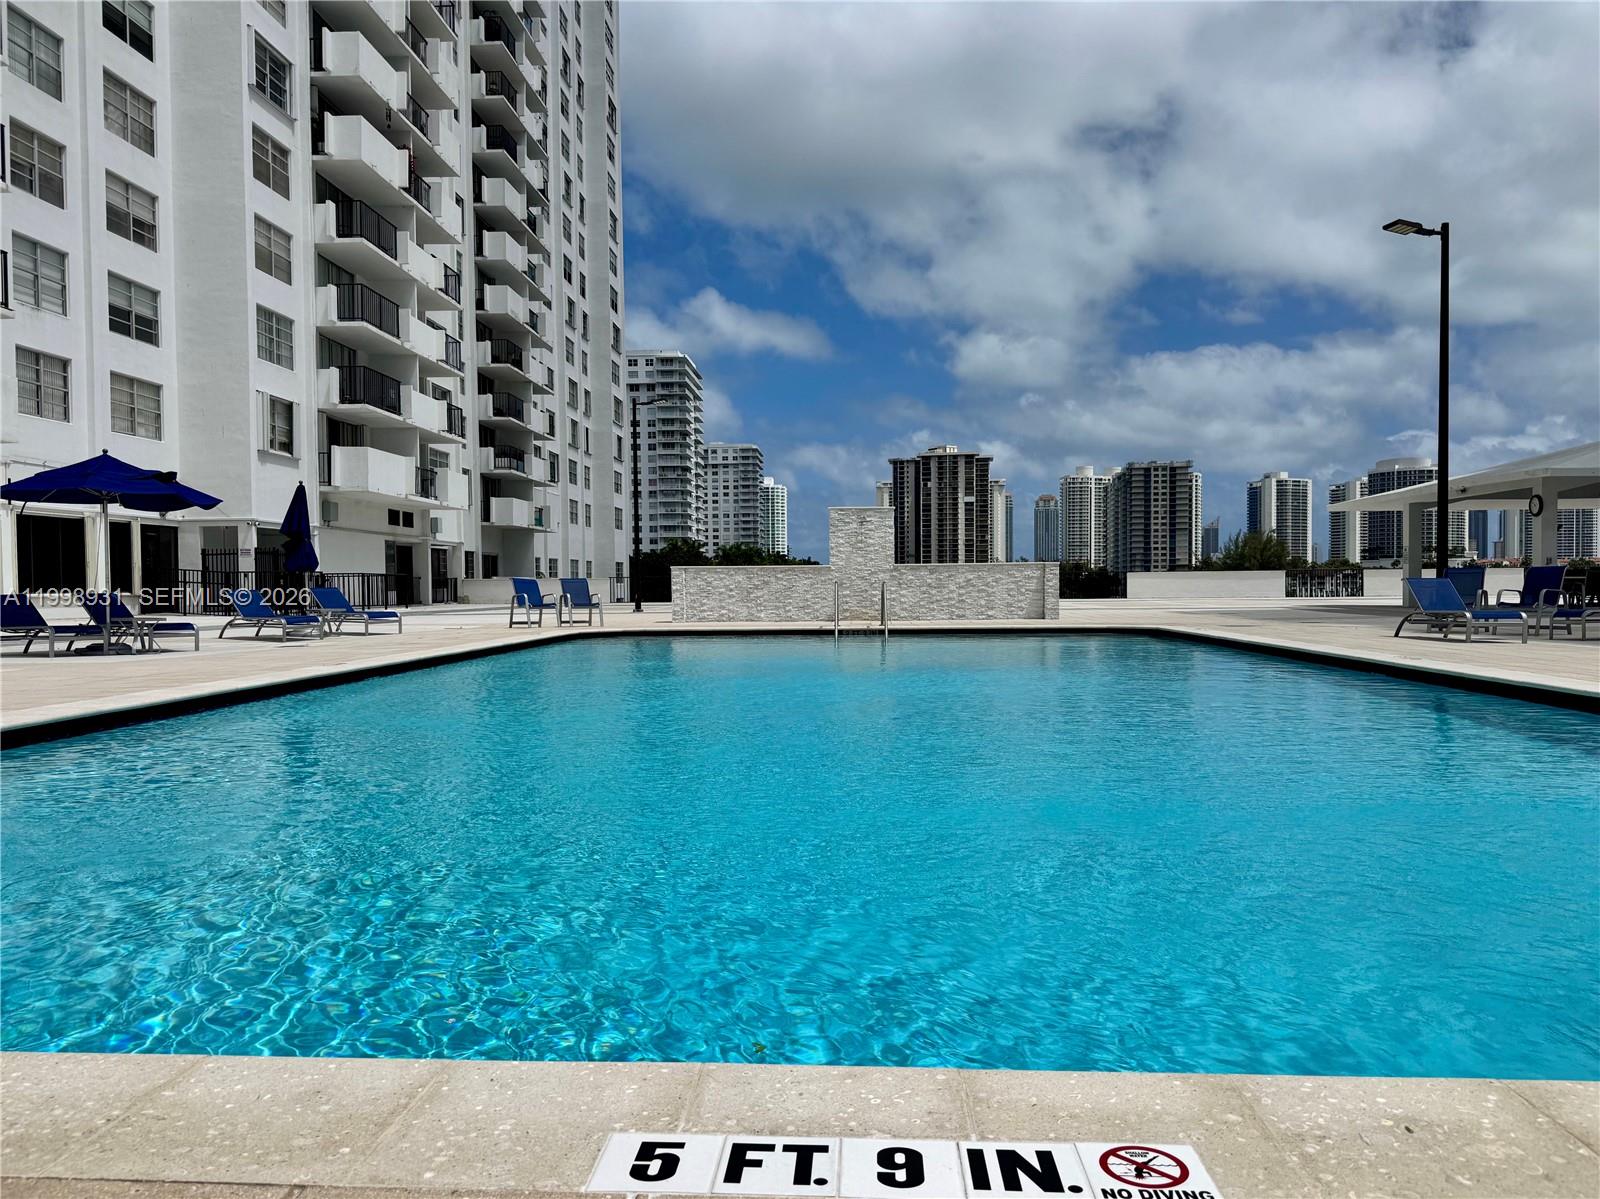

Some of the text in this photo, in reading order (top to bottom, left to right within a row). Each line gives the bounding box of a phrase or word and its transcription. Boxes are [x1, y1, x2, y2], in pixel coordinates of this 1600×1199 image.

[629, 1141, 1084, 1194] 5 FT. 9 IN.
[1101, 1188, 1215, 1199] NO DIVING
